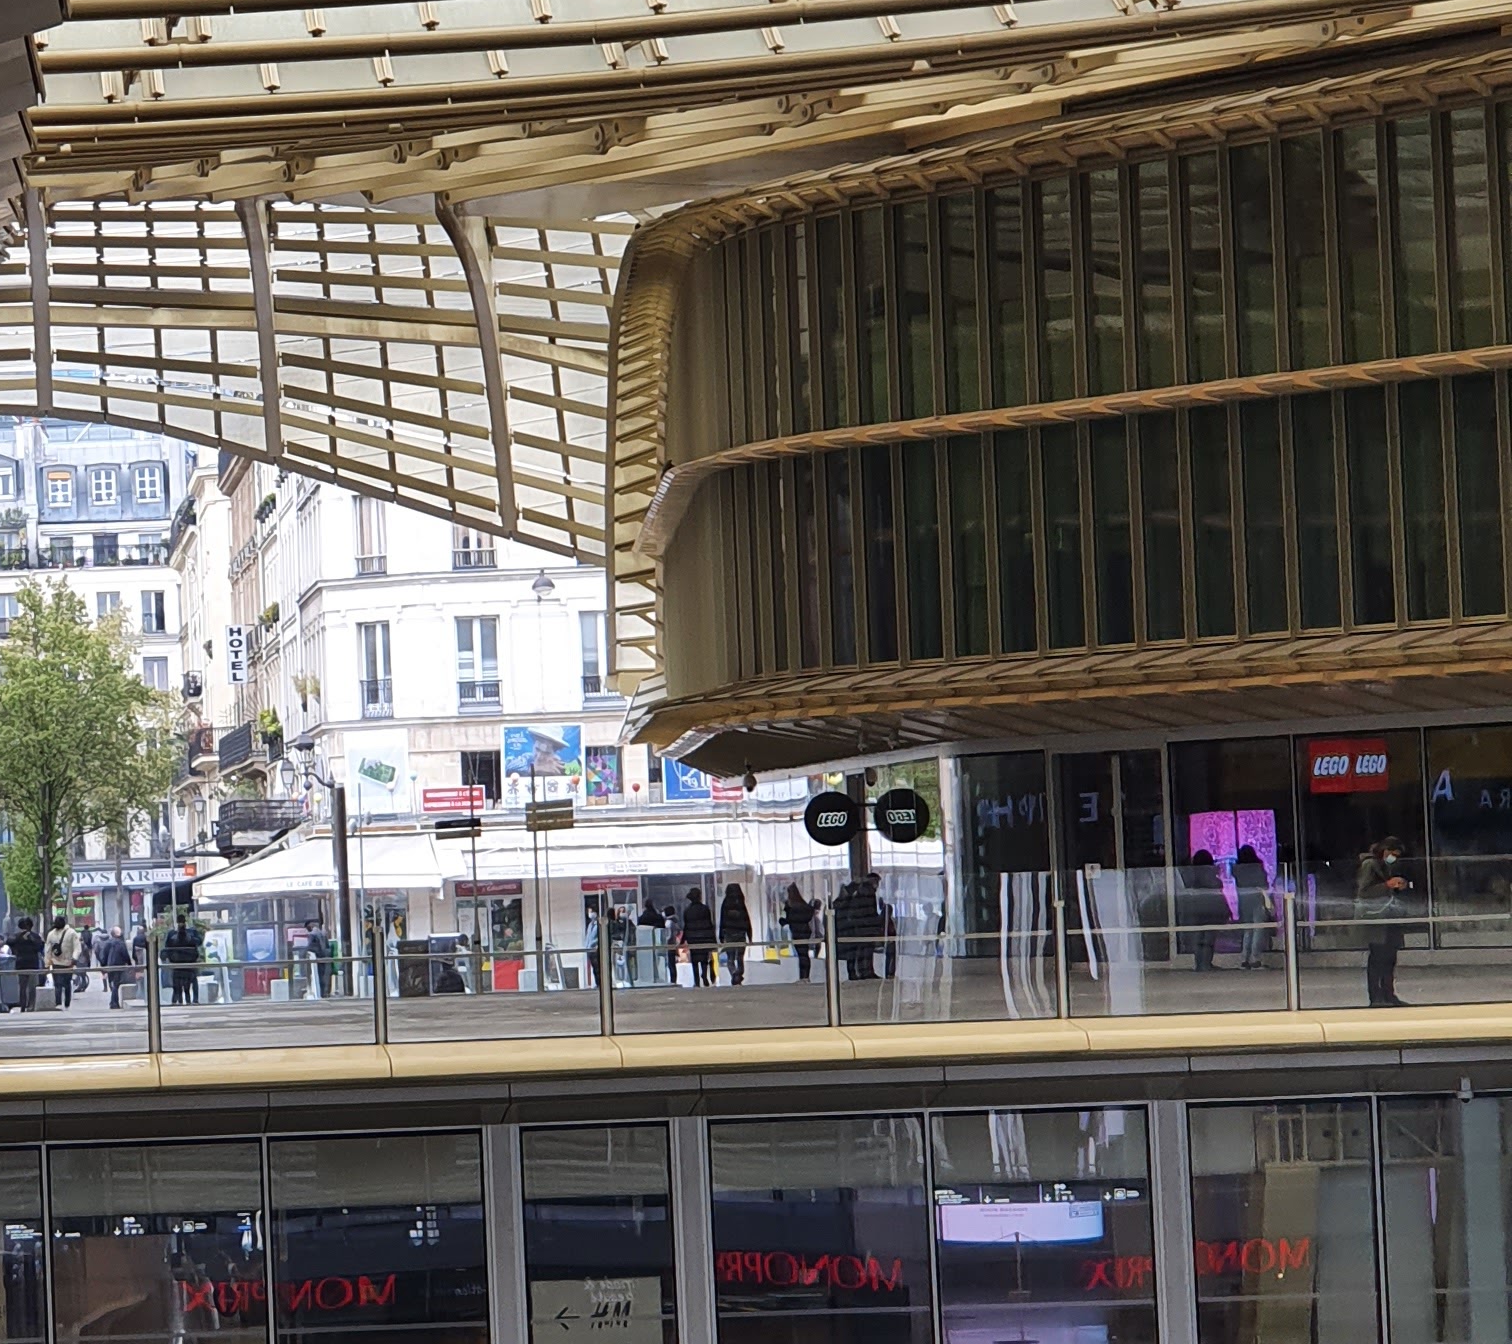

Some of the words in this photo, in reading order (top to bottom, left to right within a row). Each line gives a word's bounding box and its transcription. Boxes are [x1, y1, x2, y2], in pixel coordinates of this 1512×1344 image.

[229, 627, 244, 681] HOTEL
[1313, 755, 1349, 775] LEGO
[1355, 754, 1387, 774] LEGO
[817, 811, 847, 827] LEGO
[70, 870, 152, 886] PYSAR
